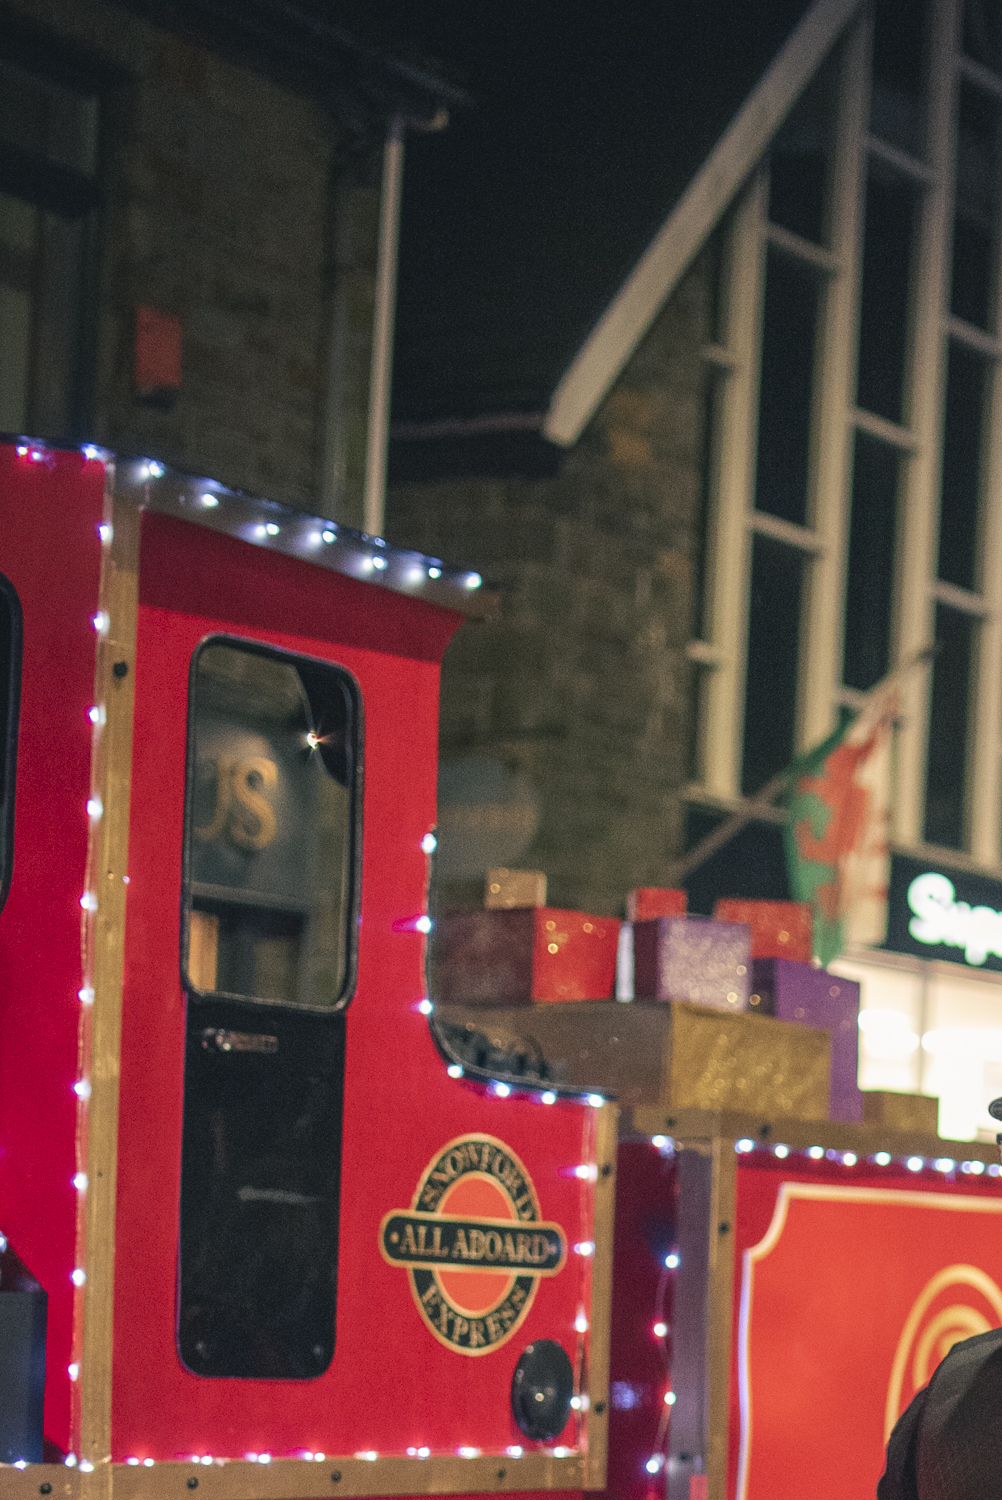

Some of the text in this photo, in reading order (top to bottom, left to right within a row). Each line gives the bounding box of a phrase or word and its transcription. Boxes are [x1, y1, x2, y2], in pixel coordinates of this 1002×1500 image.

[400, 1224, 550, 1264] ALL ABOARD
[422, 1284, 528, 1348] EXPRESS
